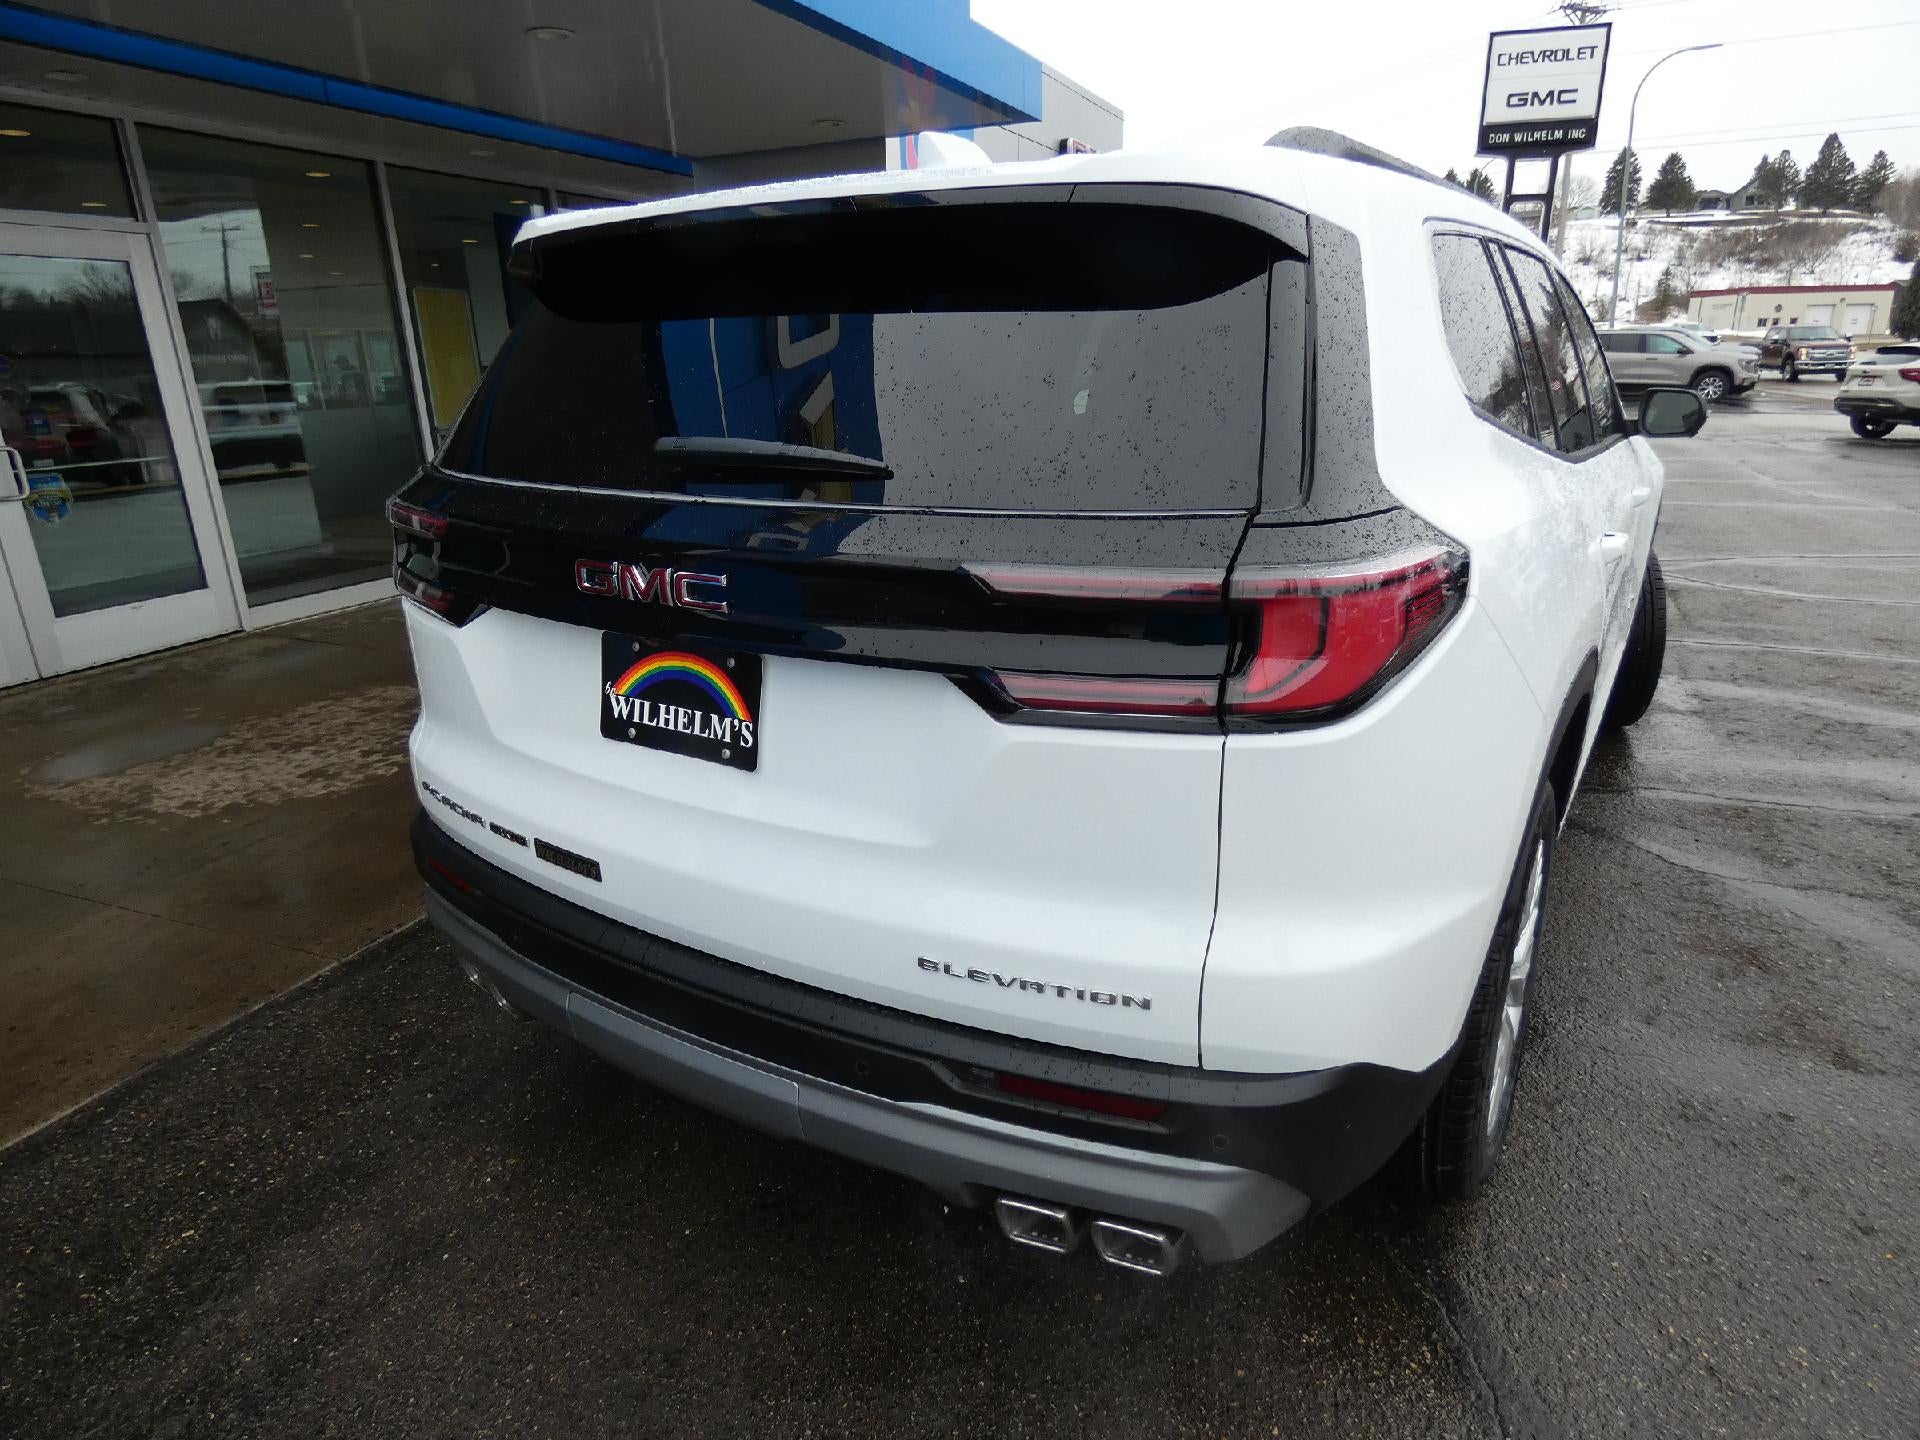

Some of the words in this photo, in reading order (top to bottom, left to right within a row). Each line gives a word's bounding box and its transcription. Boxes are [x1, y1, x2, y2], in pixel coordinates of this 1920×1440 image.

[1497, 45, 1598, 67] CHEVROLET
[1505, 88, 1578, 108] GMC
[1488, 133, 1510, 144] DON
[1514, 129, 1563, 143] WILHELM
[1567, 128, 1587, 139] INC
[575, 559, 728, 613] GMC
[610, 694, 754, 748] WILHELM'S
[917, 956, 1152, 1010] ELEVATION
